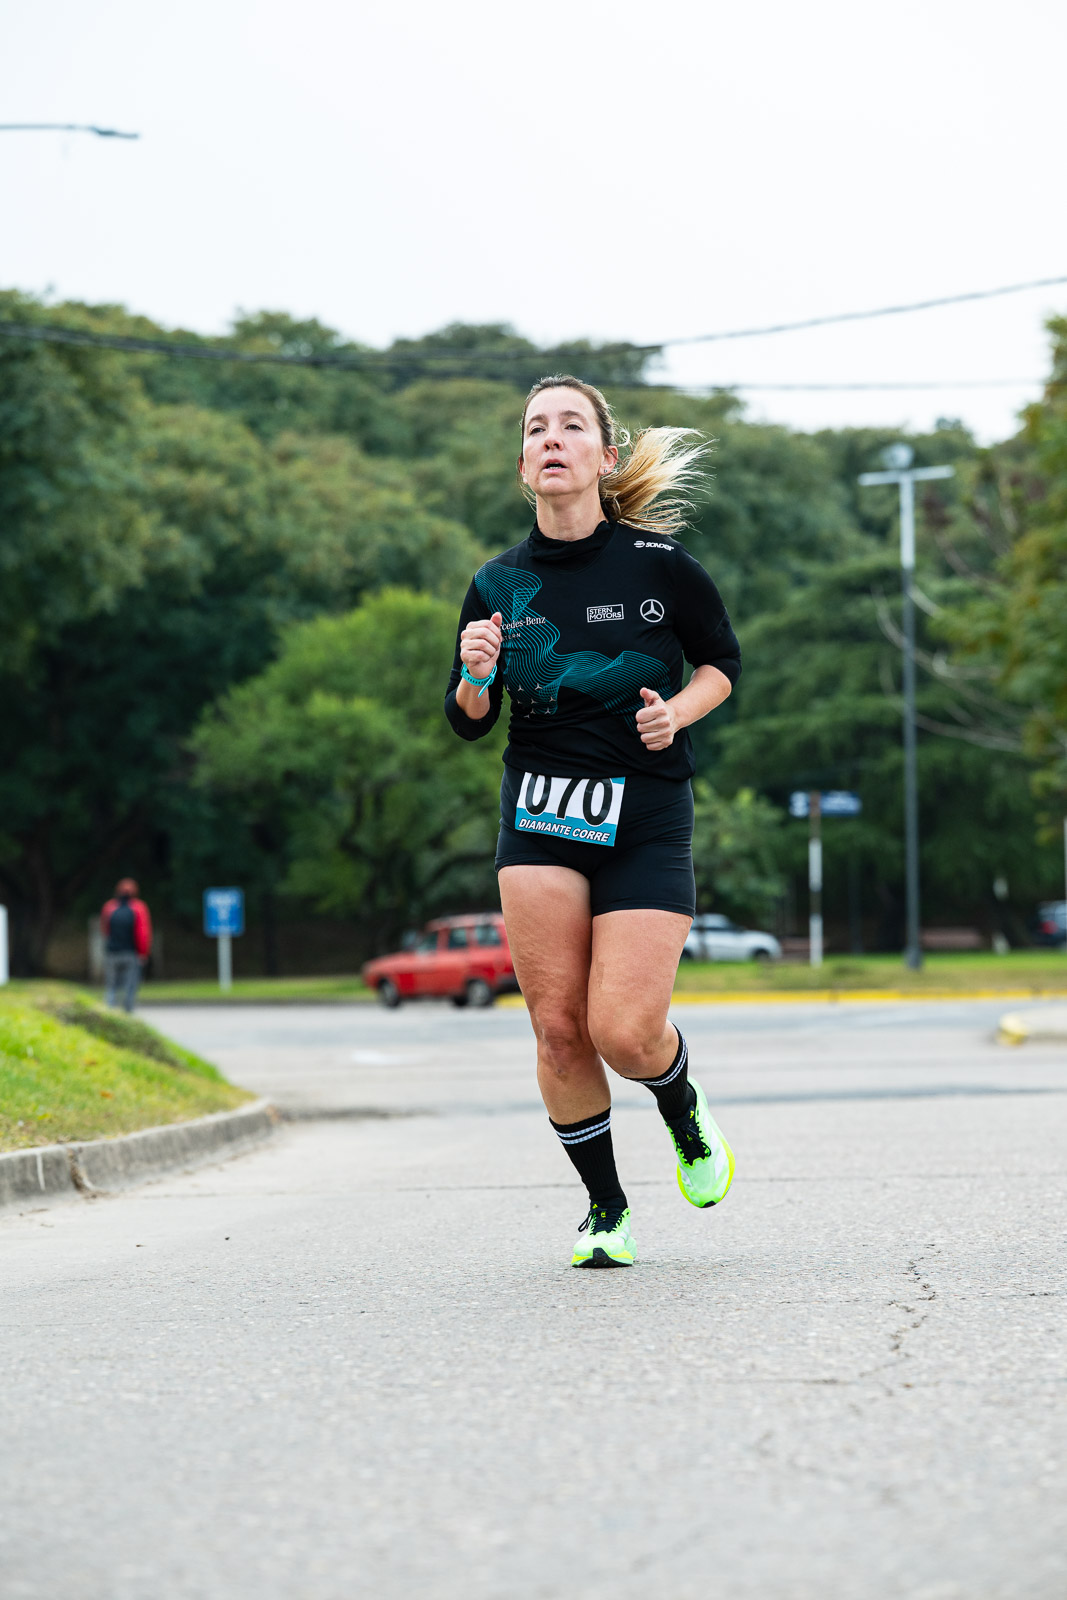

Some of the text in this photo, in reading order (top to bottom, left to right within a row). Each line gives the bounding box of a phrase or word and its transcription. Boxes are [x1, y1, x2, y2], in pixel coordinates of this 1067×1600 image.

[589, 606, 613, 615] STERN
[589, 611, 622, 621] MOTORS
[500, 616, 546, 631] cedes-Benz
[525, 774, 614, 828] 070
[518, 818, 611, 843] DIAMANTE CORRE
